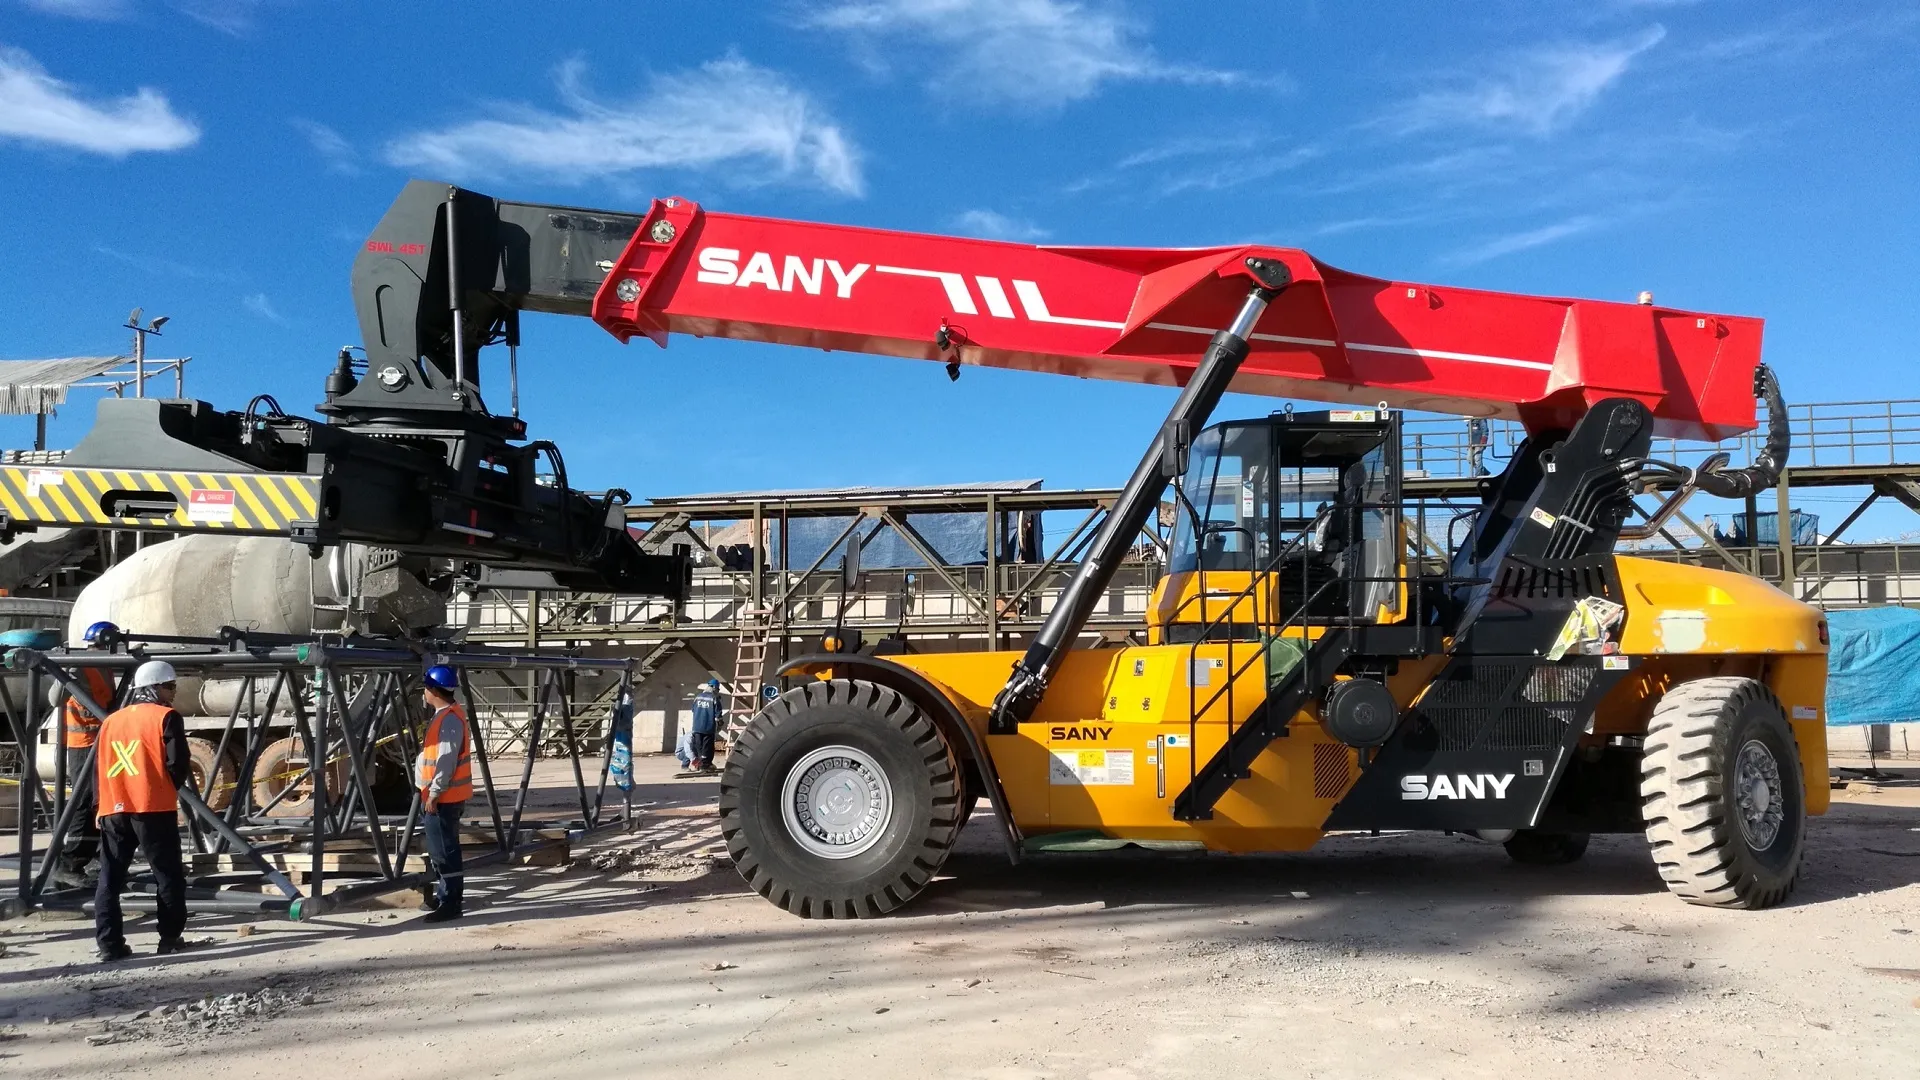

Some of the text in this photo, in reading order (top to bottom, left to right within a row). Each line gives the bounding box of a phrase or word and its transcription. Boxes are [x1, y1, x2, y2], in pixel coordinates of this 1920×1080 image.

[367, 240, 427, 255] SWL 45T
[697, 246, 871, 299] SANY
[207, 493, 226, 501] DANGER
[1051, 726, 1113, 741] SANY
[1400, 773, 1516, 800] SANY
